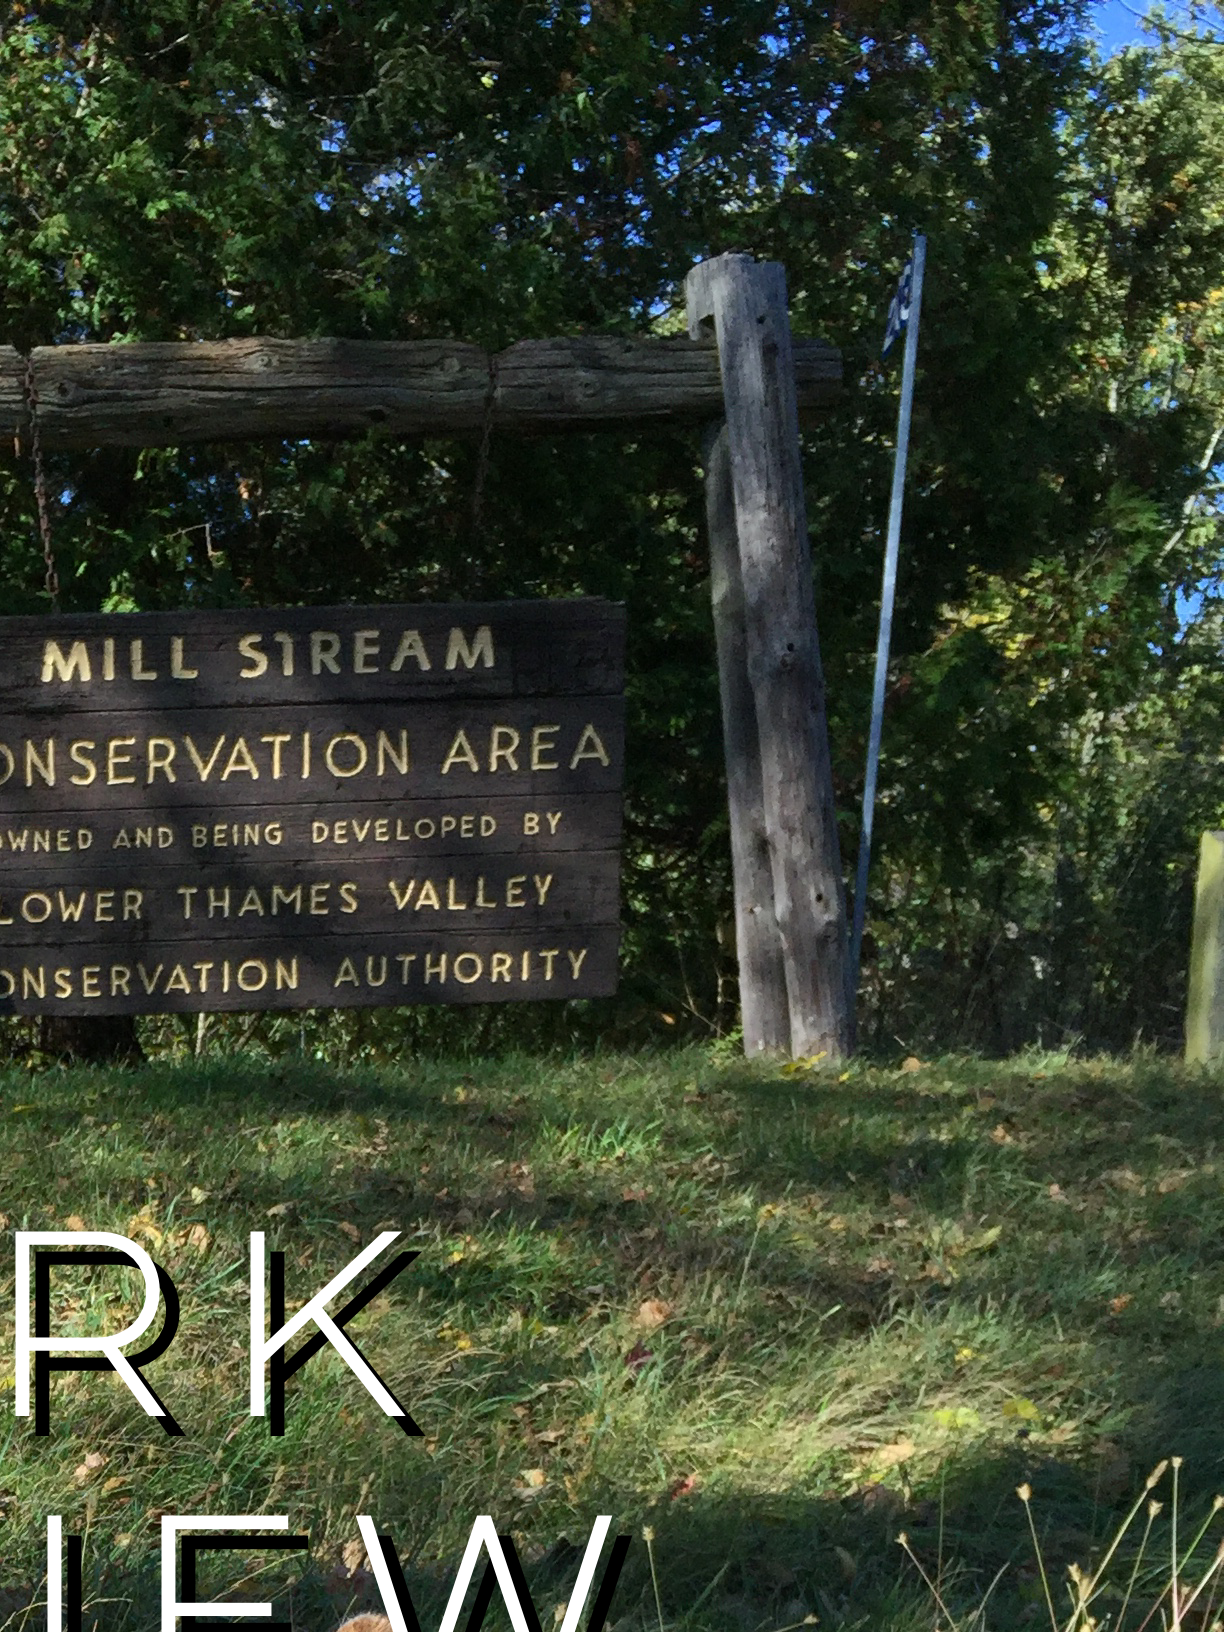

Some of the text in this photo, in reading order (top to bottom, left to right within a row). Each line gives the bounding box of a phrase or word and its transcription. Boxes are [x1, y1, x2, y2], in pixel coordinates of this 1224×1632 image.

[40, 626, 494, 683] MILL STREAM
[442, 724, 610, 774] AREA
[113, 826, 174, 849] AND
[192, 823, 283, 848] BEING
[312, 814, 497, 844] DEVELOPED
[524, 812, 563, 836] BY
[177, 882, 358, 920] THAMES
[389, 873, 553, 911] VALLEY
[333, 949, 588, 988] AUTHORITY
